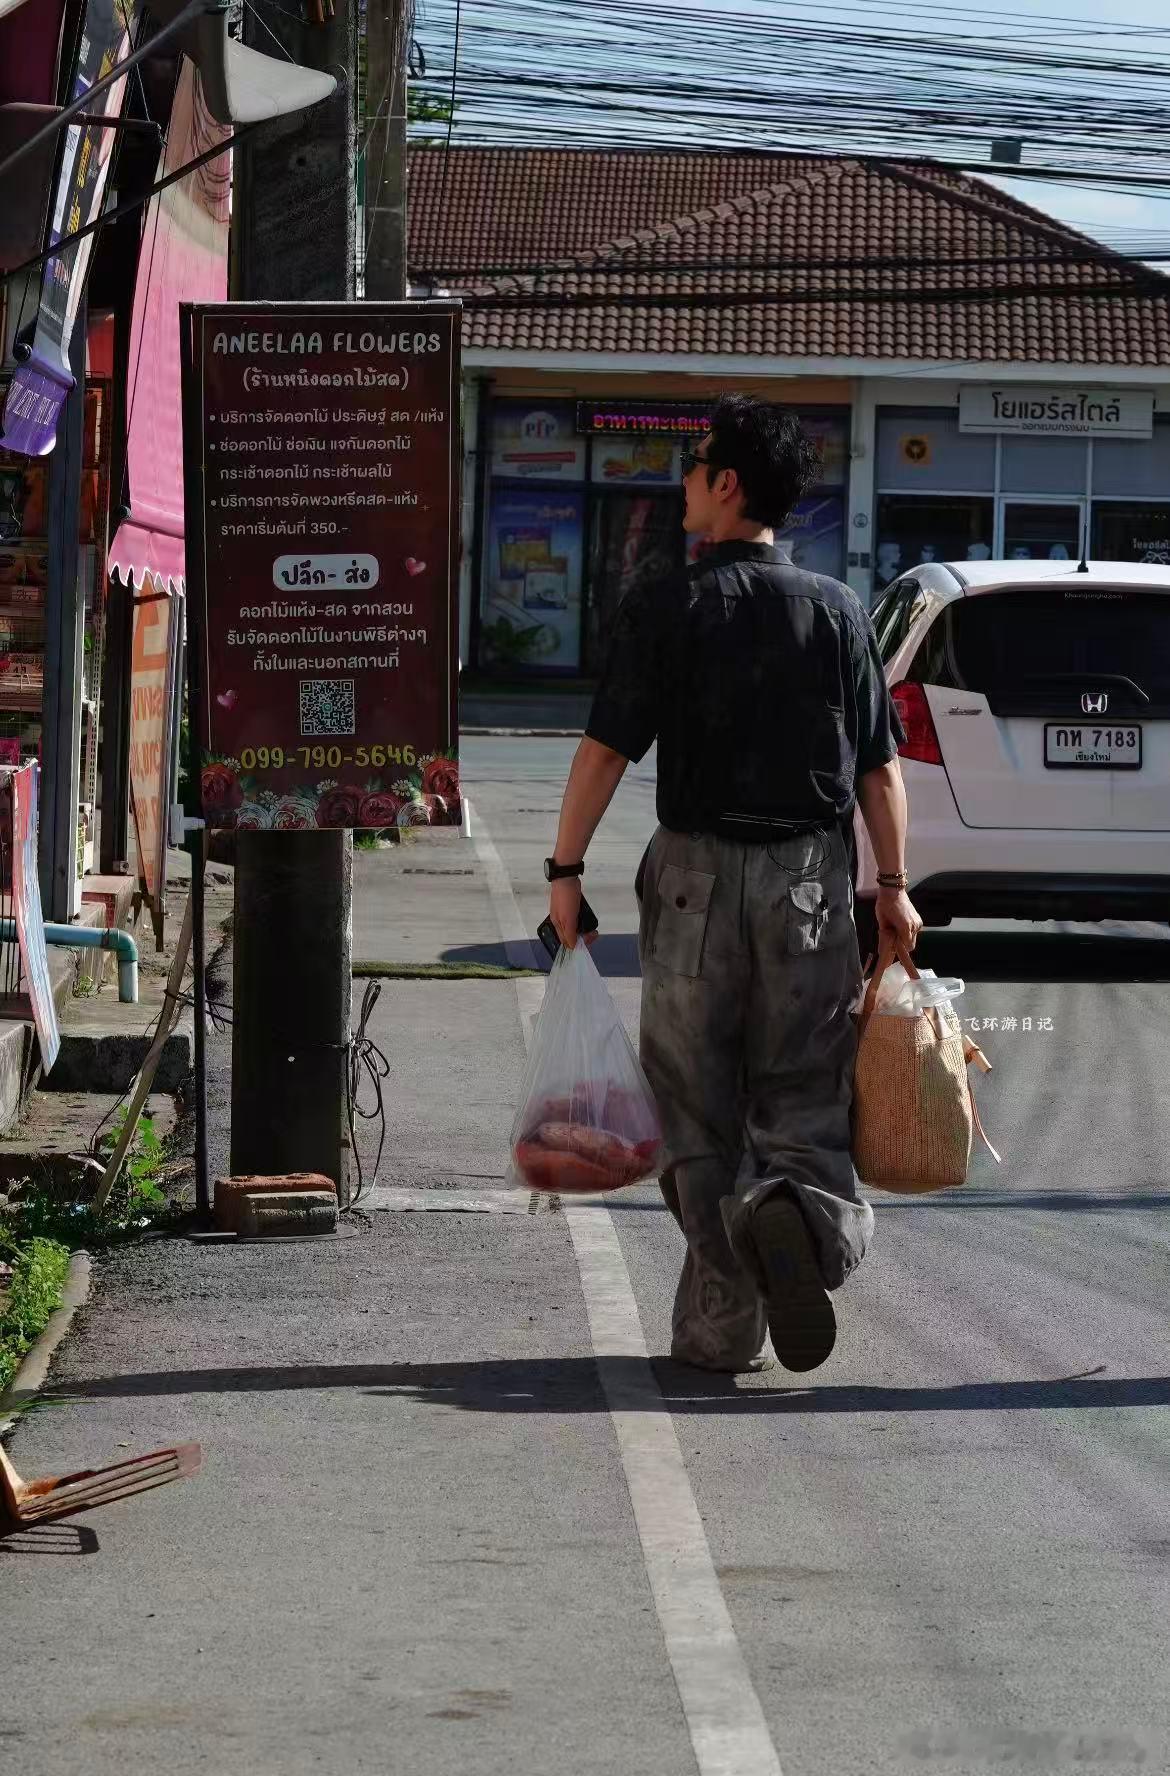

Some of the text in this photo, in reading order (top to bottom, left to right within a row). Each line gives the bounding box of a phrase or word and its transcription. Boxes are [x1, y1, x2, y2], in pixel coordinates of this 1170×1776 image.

[213, 332, 441, 355] ANEELAA FLOWERS
[220, 408, 328, 424] บริการจัดดอกไม้
[390, 410, 410, 423] สด
[219, 435, 411, 452] ช่อดอกไม้ ช่อเงิน แจกันดอกไม้
[220, 463, 392, 480] กระเช้าดอกไม้ กระเช้าผลไม้
[221, 516, 349, 536] ราคาเริ่มต้นที่ 350.-
[345, 559, 370, 584] ส่ง
[239, 601, 413, 618] ดอกไม้แห้ง-สด จากสวน
[253, 647, 400, 671] ทั้งในและนอกสถานที่
[1092, 730, 1137, 749] 7183
[240, 744, 417, 770] 099-790-5646
